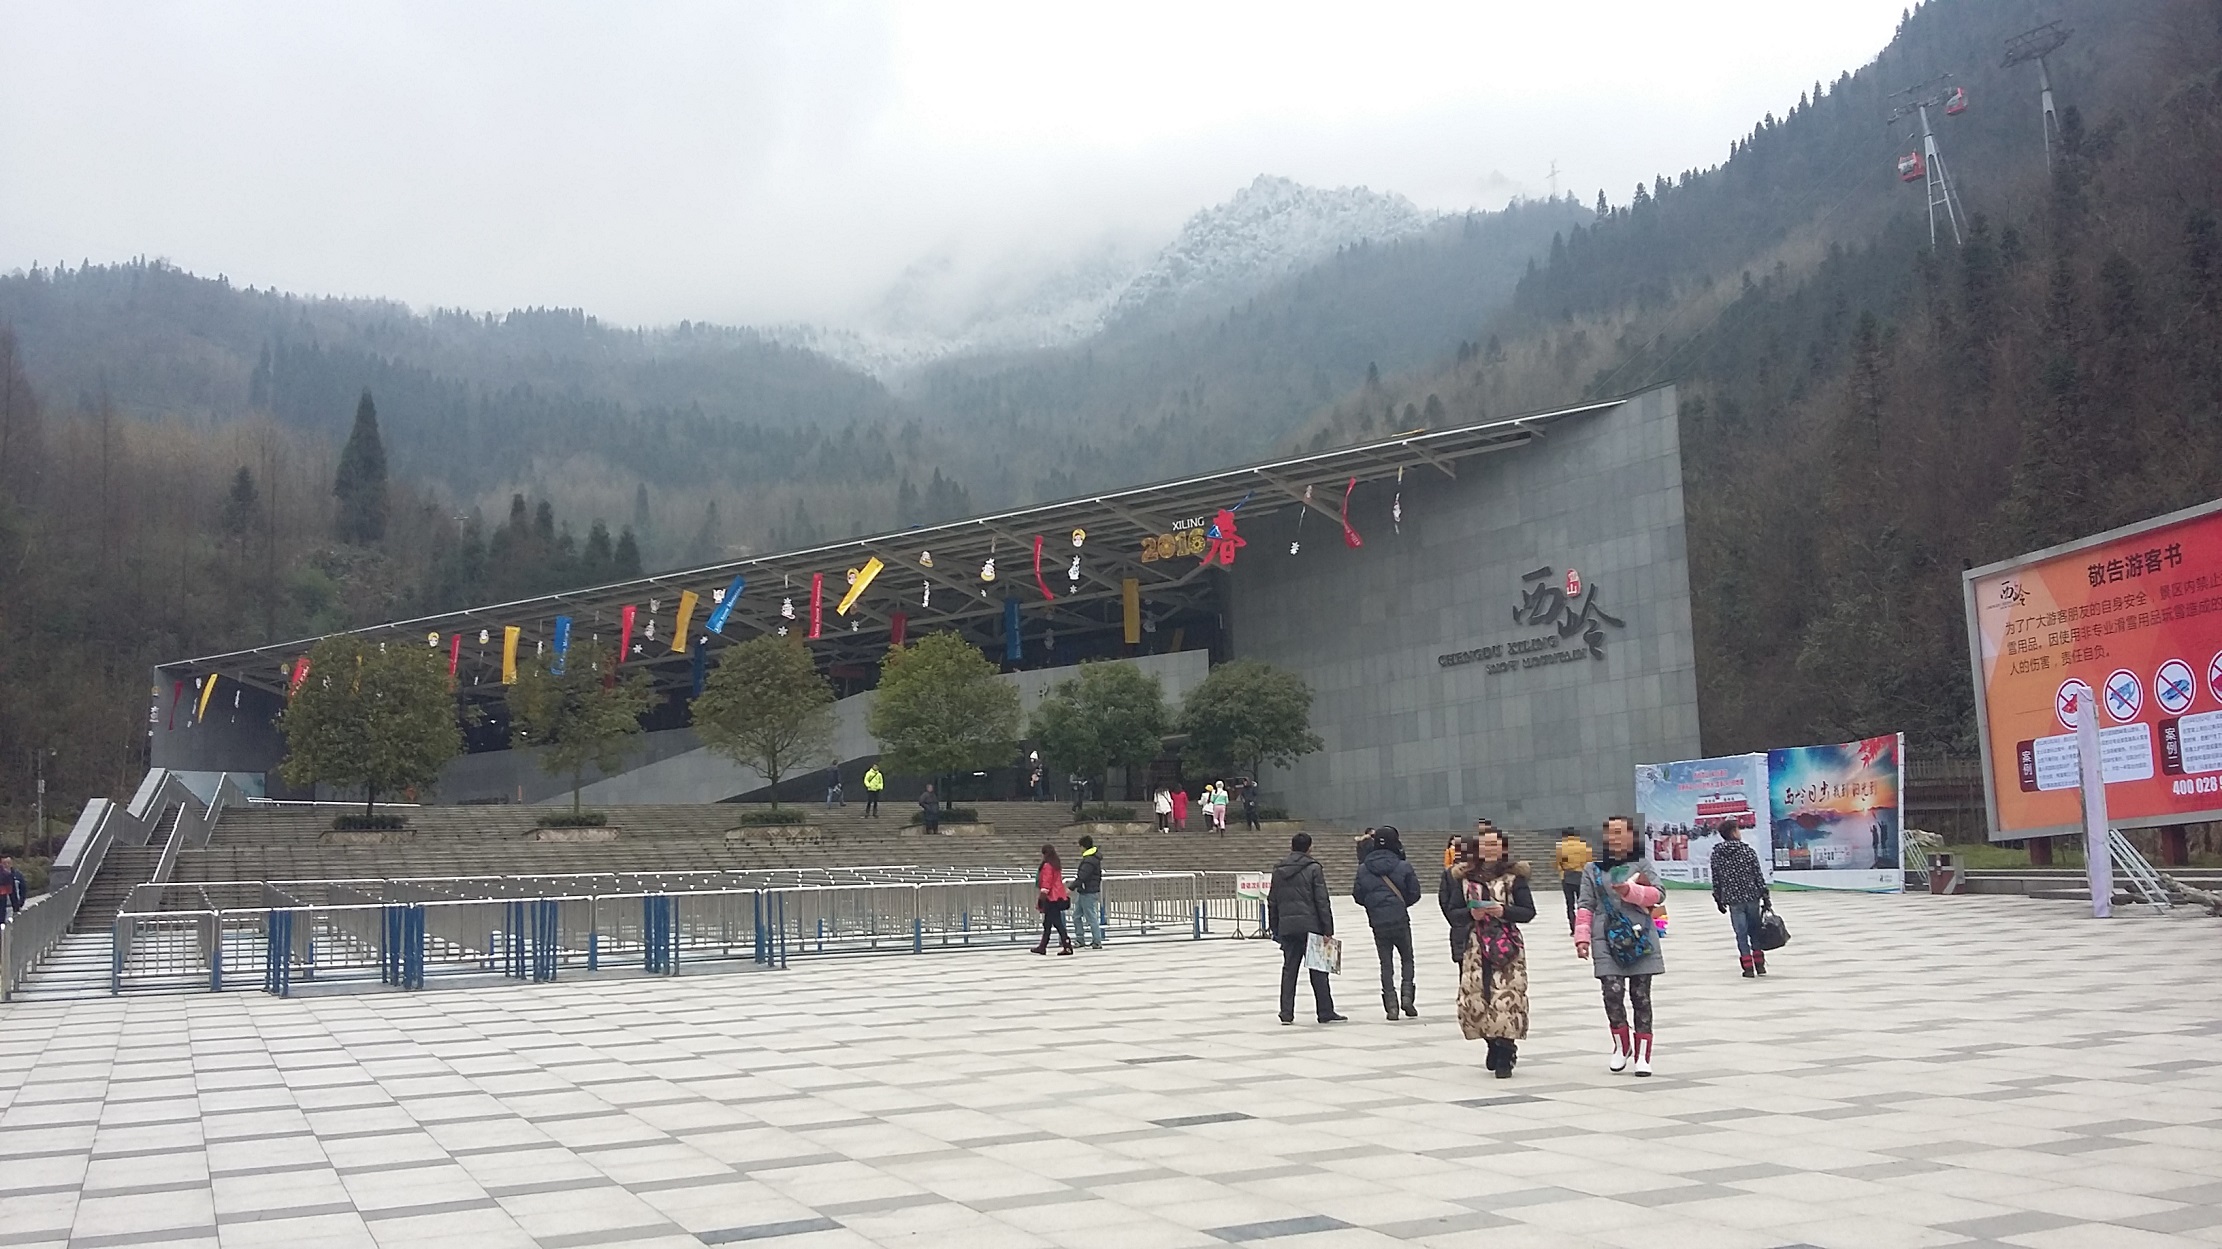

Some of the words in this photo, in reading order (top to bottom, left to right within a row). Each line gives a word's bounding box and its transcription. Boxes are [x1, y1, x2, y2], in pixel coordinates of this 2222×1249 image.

[1172, 516, 1205, 531] XILING
[1199, 508, 1247, 565] 春
[1141, 527, 1206, 563] 2016
[2087, 543, 2182, 588] 敬告游客书
[1507, 635, 1559, 655] XILING
[2173, 779, 2195, 795] 400
[2196, 776, 2218, 794] 028
